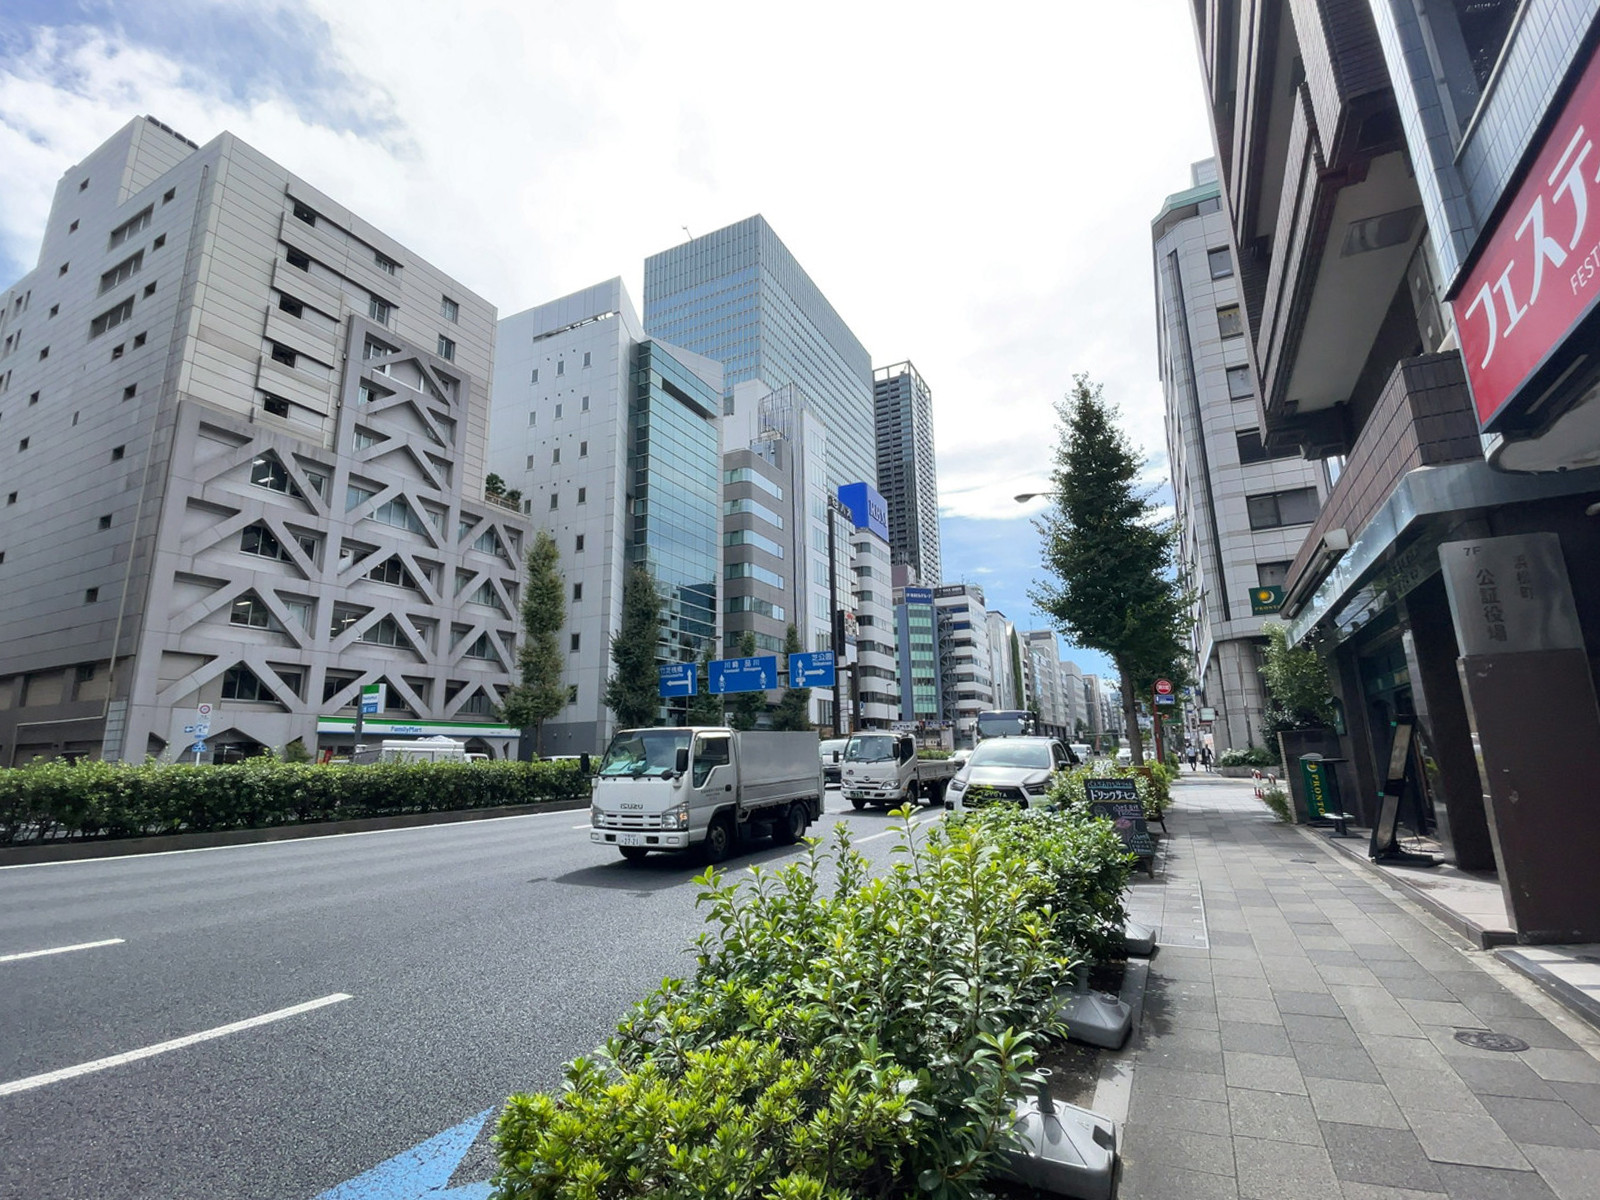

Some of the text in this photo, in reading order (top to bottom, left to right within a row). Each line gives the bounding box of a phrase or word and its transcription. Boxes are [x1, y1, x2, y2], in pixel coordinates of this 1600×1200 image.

[1465, 125, 1600, 369] フェステ
[1570, 241, 1600, 296] FEST
[1463, 546, 1481, 557] 7F
[1513, 554, 1534, 600] 浜松町
[1476, 567, 1508, 642] 公証役場
[390, 725, 422, 734] FamilyMart
[1311, 773, 1326, 816] PRONTO
